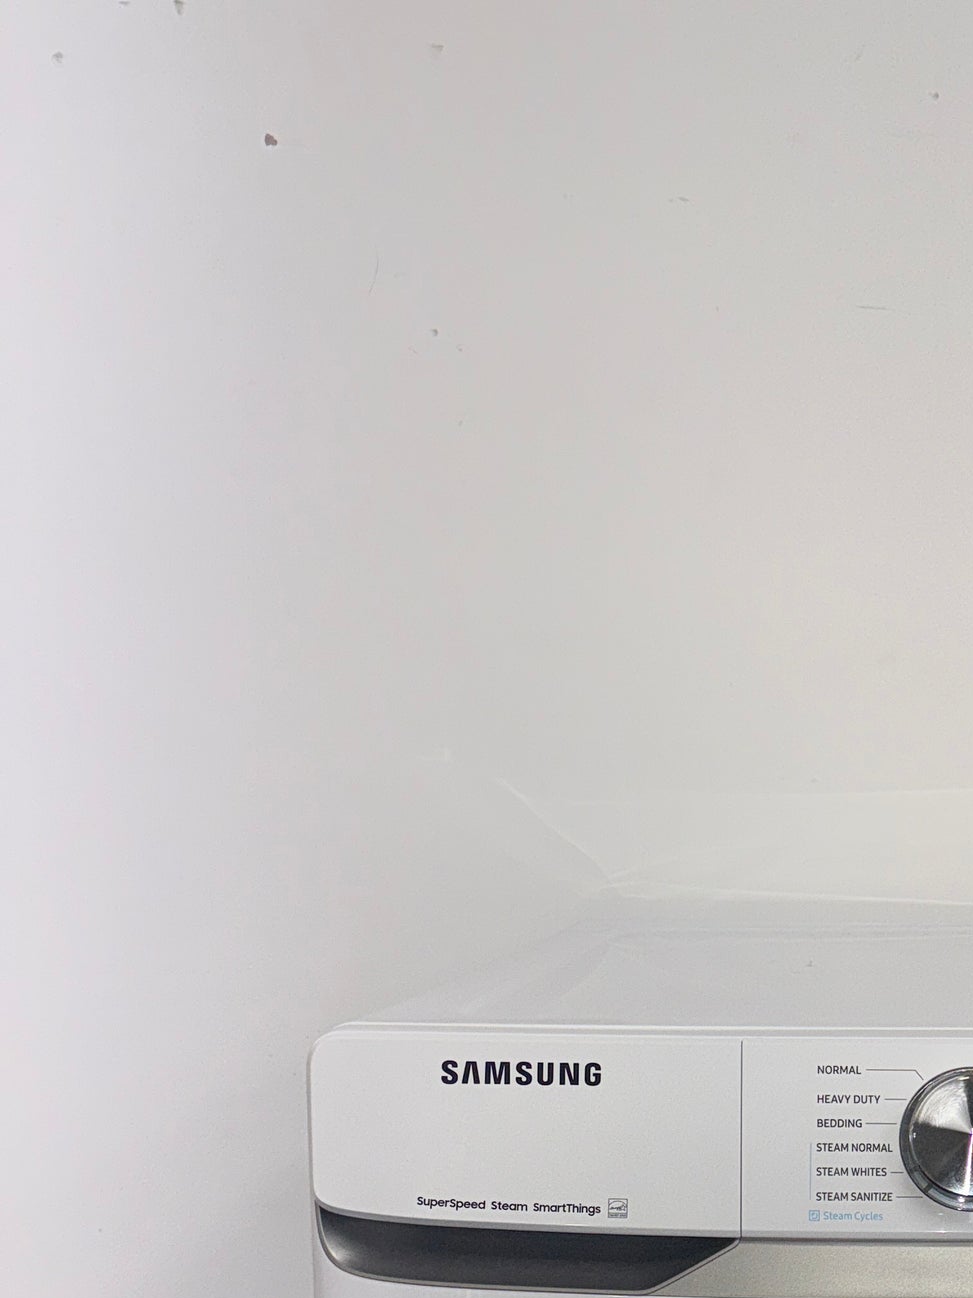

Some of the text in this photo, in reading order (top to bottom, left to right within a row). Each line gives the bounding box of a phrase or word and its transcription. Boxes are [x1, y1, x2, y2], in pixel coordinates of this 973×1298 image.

[441, 1060, 601, 1086] SAMSUNG
[817, 1065, 862, 1075] NORMAL
[816, 1094, 881, 1104] HEAVY DUTY
[816, 1118, 862, 1128] BEDDING
[816, 1142, 893, 1152] STEAM NORMAL
[816, 1167, 888, 1177] STEAM WHITES
[815, 1191, 893, 1201] STEAM SANITIZE
[417, 1197, 601, 1216] SuperSpeed Steam SmartThings
[822, 1210, 883, 1222] Steam Cycles
